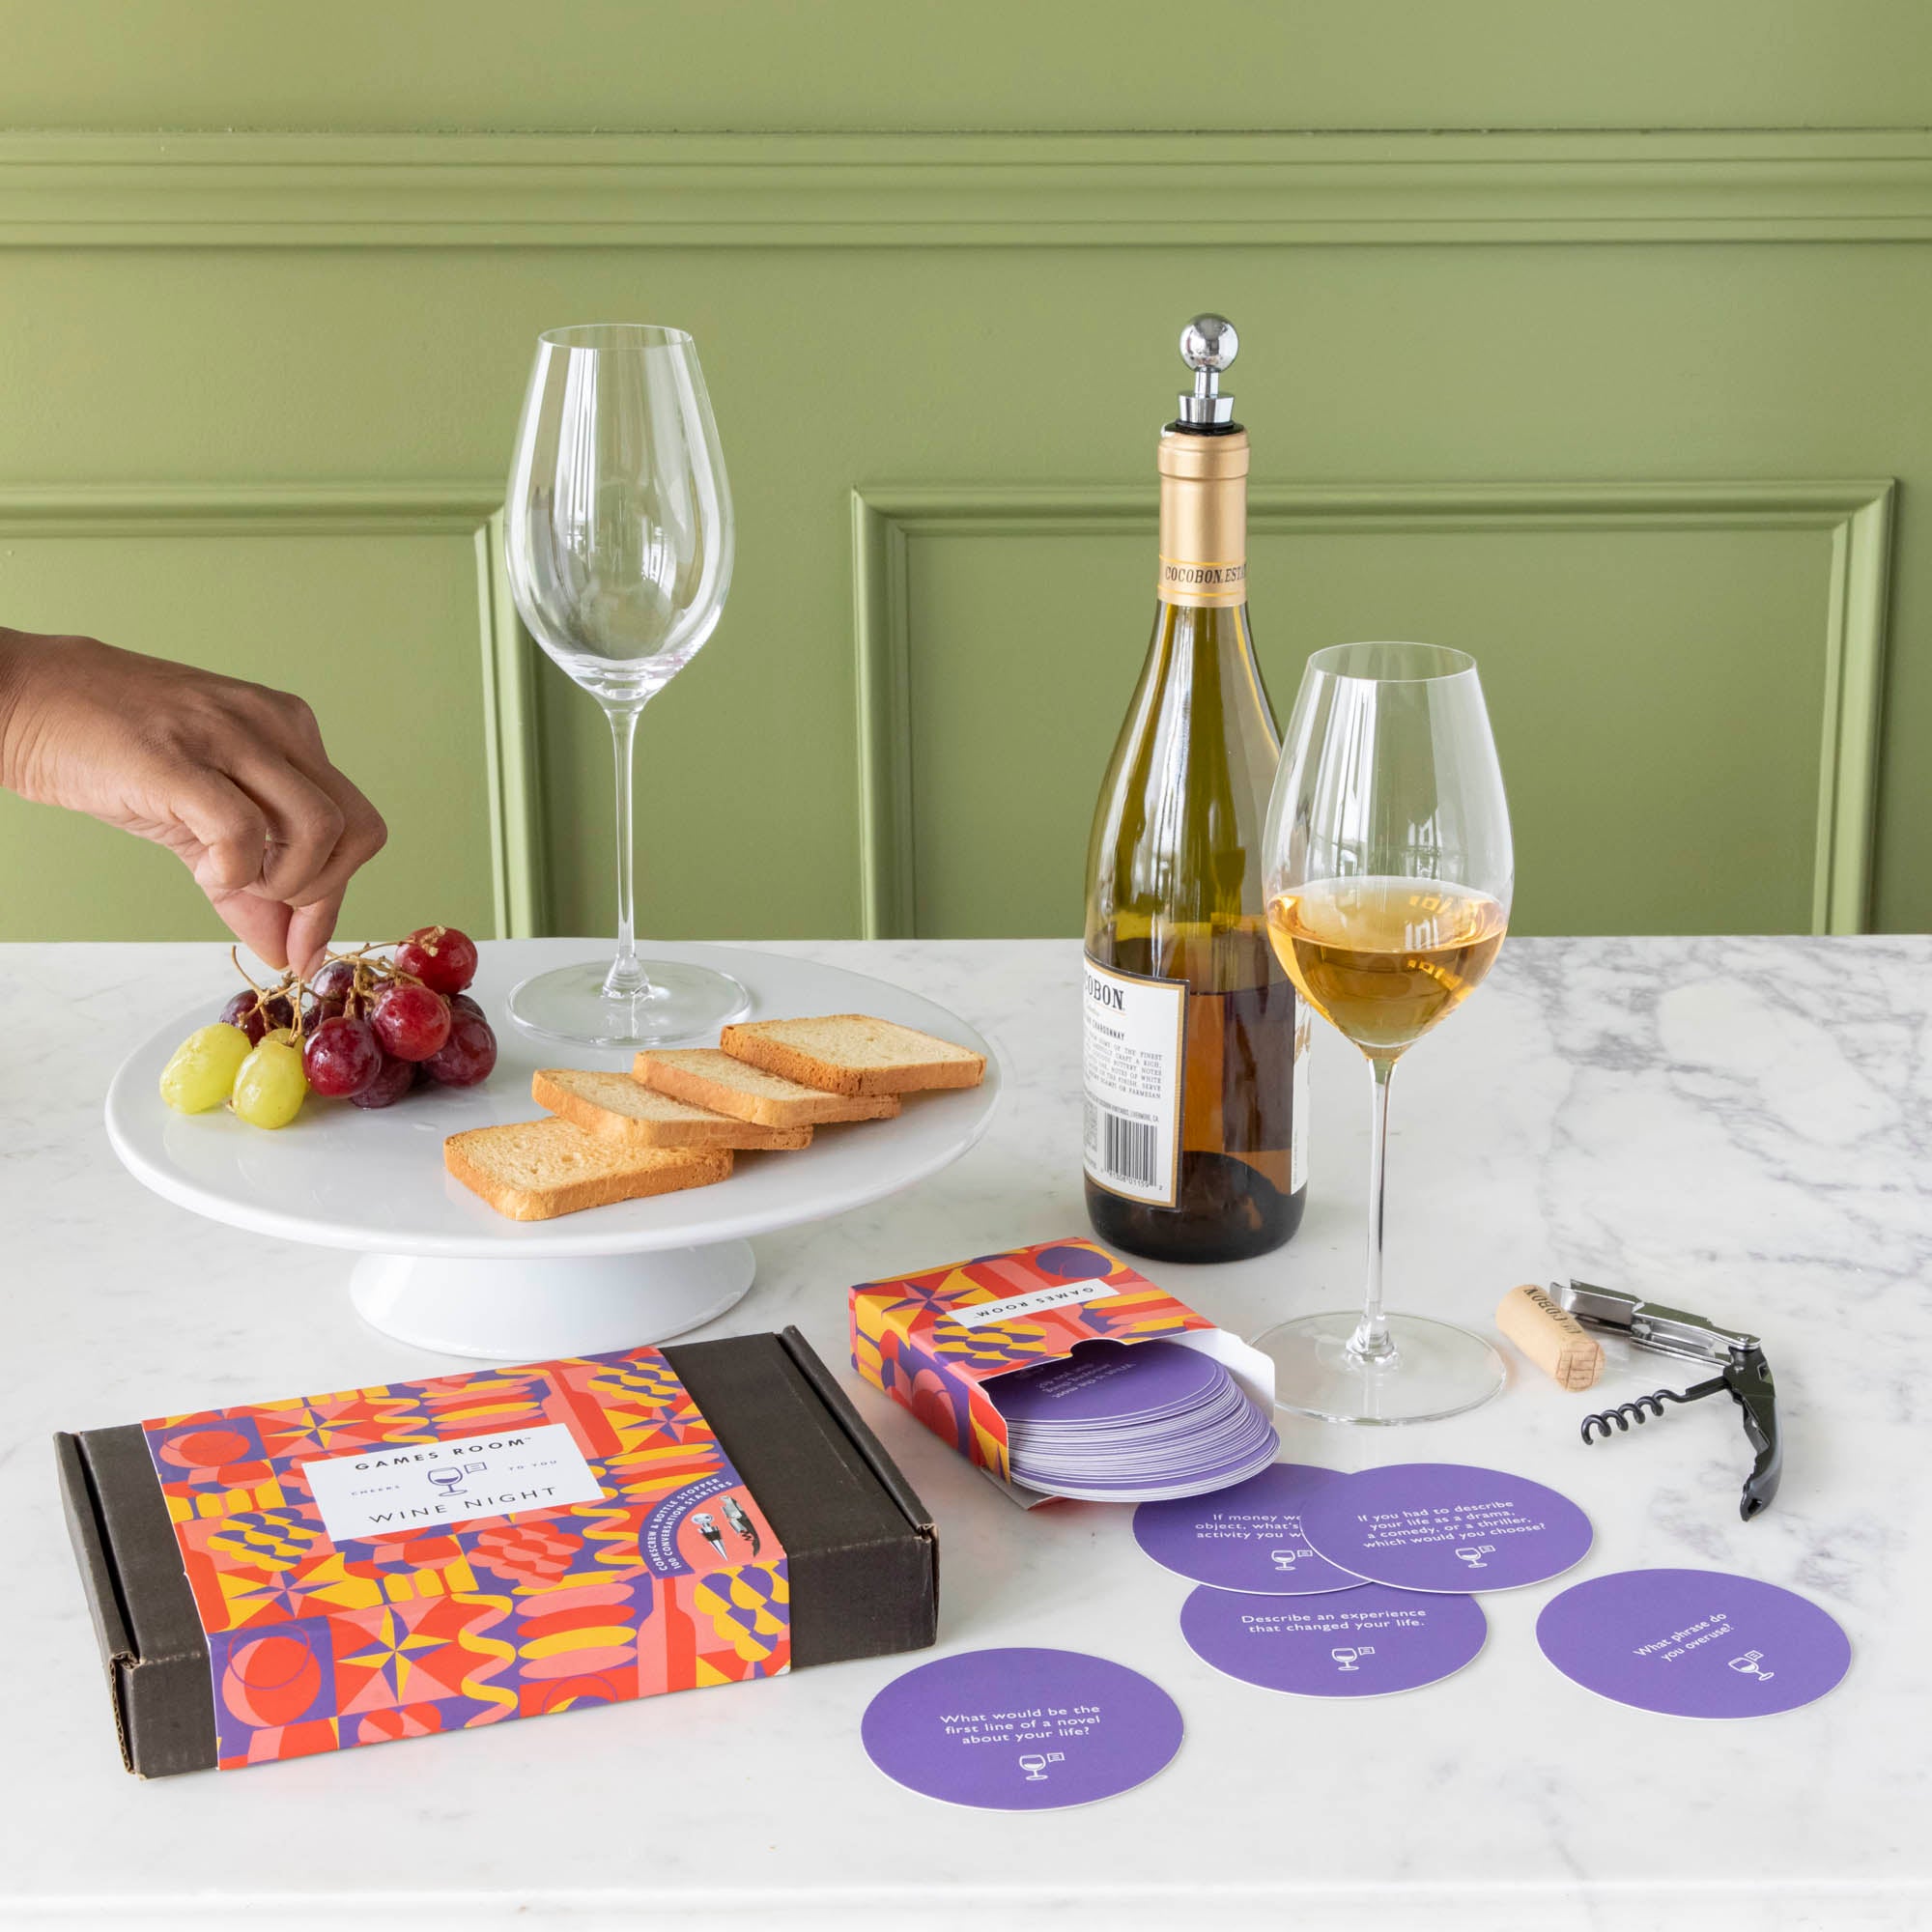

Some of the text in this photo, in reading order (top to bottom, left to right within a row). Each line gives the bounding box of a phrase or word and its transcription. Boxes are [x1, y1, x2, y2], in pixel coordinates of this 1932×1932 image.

[1166, 565, 1222, 583] COCOBON
[1141, 1051, 1163, 1061] FINEST
[1036, 1287, 1094, 1303] GAMES
[355, 1452, 439, 1470] GAMES
[351, 1484, 401, 1496] CHEERS
[532, 1460, 558, 1468] YOU
[676, 1478, 721, 1499] STOPPER
[369, 1487, 556, 1523] WINE NIGHT
[653, 1500, 678, 1522] BOTTLE
[1373, 1513, 1399, 1522] you
[1403, 1509, 1430, 1519] had
[1455, 1501, 1515, 1513] describe
[661, 1481, 732, 1569] 100 CONVERSATION STARTERS
[1370, 1522, 1403, 1532] your
[1406, 1518, 1430, 1526] life
[1466, 1510, 1515, 1520] drama,
[1379, 1526, 1440, 1538] comedy,
[1478, 1517, 1532, 1528] thriller,
[1197, 1531, 1252, 1540] activity
[1363, 1522, 1546, 1548] which would you choose?
[647, 1531, 668, 1571] CORKSCREW
[1241, 1614, 1312, 1623] Describe
[1341, 1609, 1427, 1621] experience
[1287, 1622, 1350, 1633] changed
[1354, 1621, 1391, 1631] your
[1633, 1613, 1727, 1657] What phrase do
[1662, 1623, 1735, 1662] you overuse?
[940, 1714, 987, 1723] What
[993, 1708, 1042, 1719] would
[945, 1725, 980, 1735] first
[1020, 1719, 1037, 1729] of
[1058, 1716, 1100, 1726] novel
[962, 1726, 1090, 1745] about your life?
